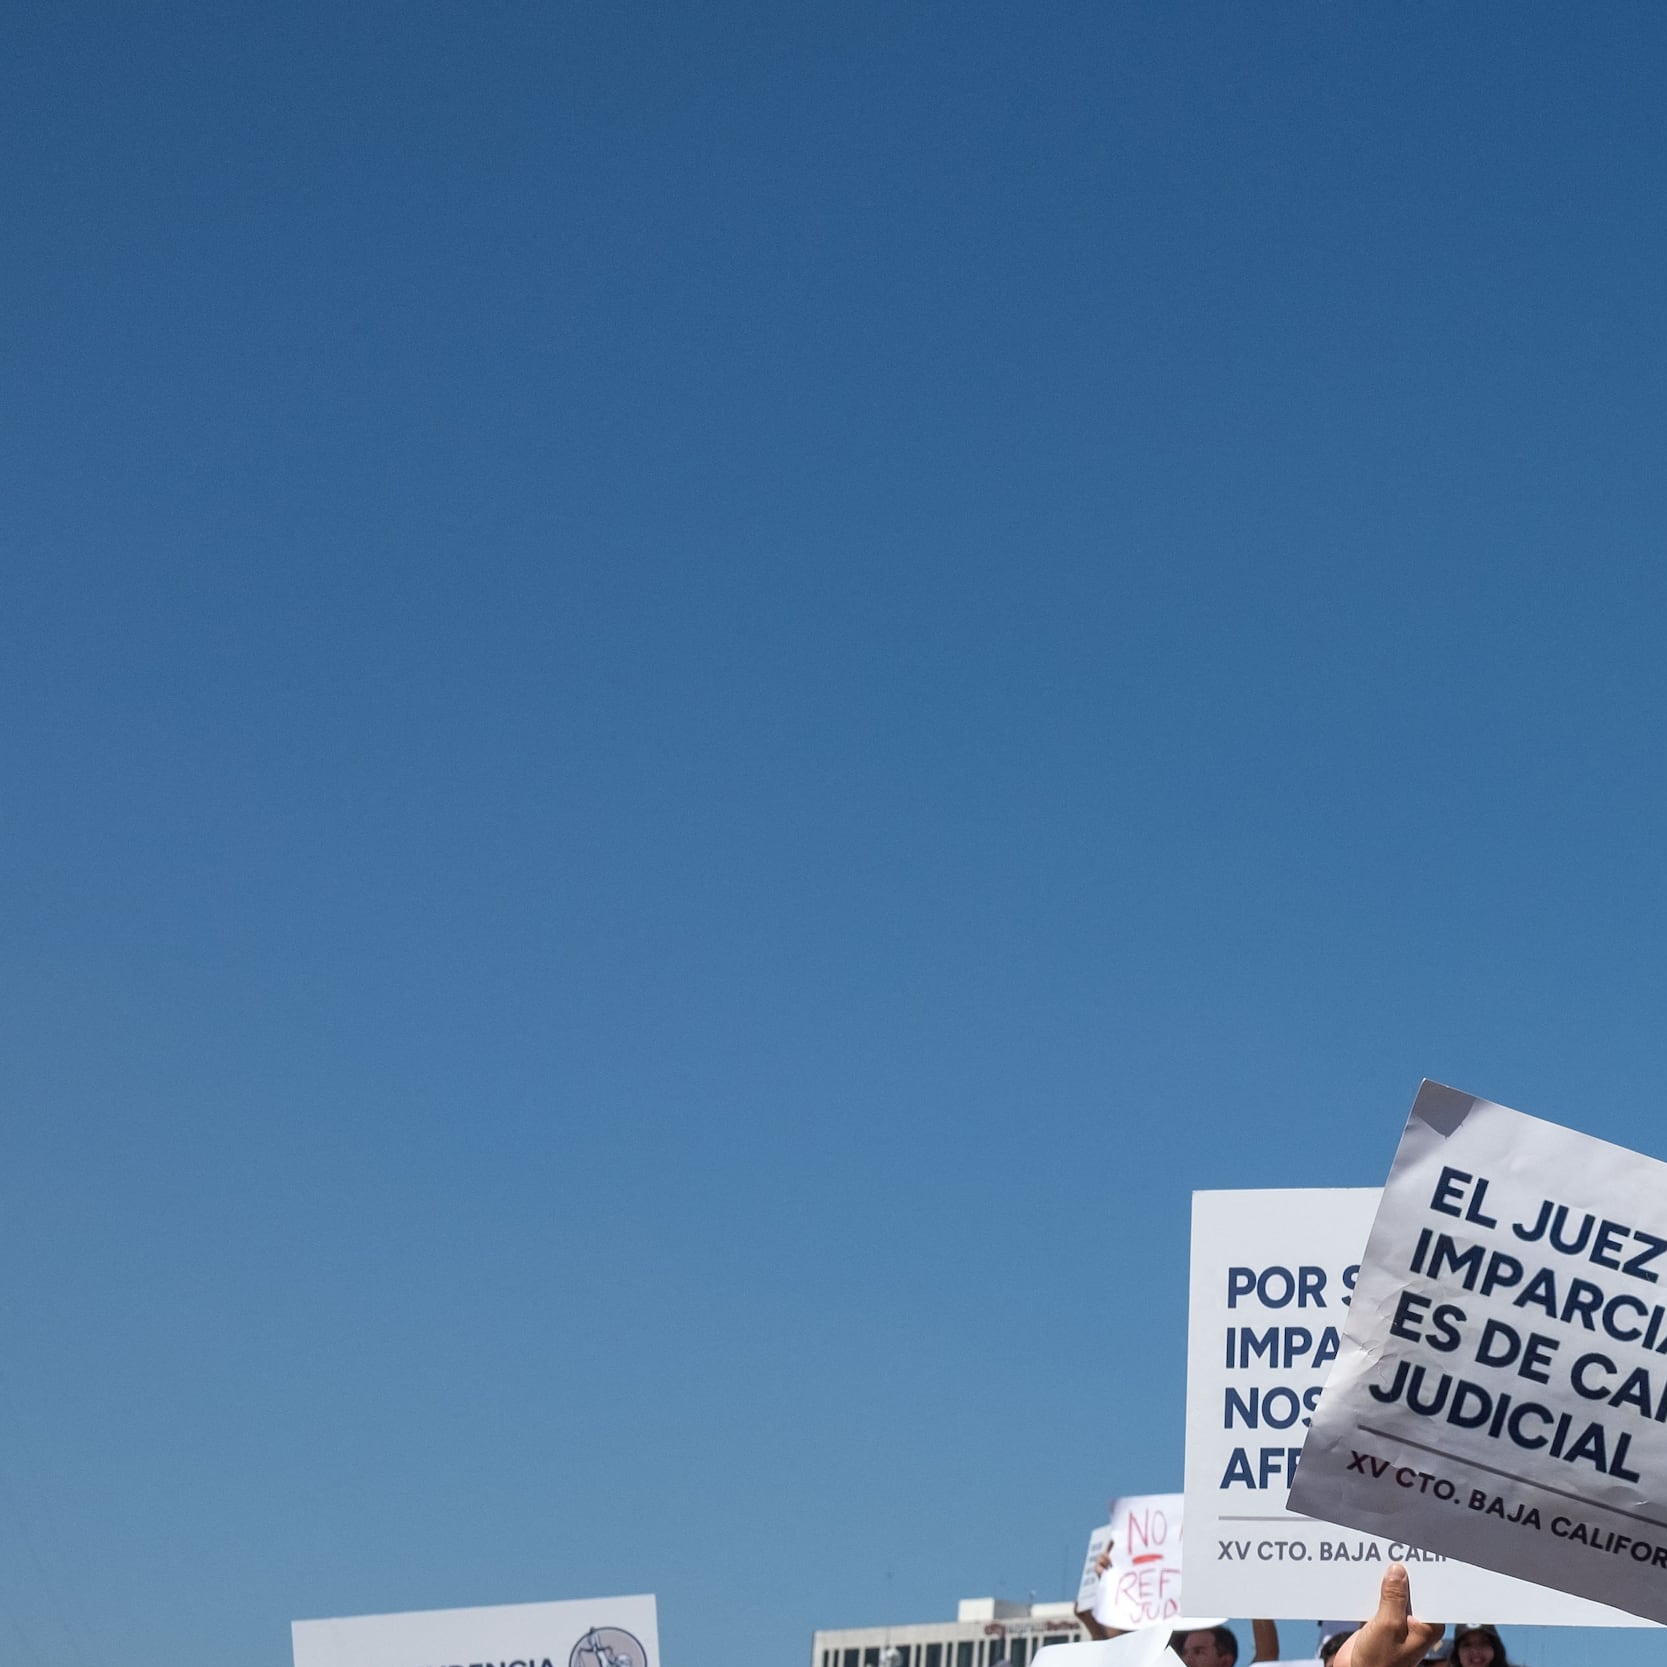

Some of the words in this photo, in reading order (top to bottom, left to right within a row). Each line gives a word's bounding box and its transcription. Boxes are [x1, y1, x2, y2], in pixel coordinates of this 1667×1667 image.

[1430, 1166, 1497, 1229] EL
[1228, 1266, 1327, 1308] POR
[1390, 1291, 1467, 1353] ES
[1475, 1318, 1560, 1385] DE
[1224, 1386, 1325, 1430] NOS
[1369, 1361, 1640, 1484] JUDICIAL
[1347, 1450, 1391, 1479] XV
[1395, 1466, 1460, 1505] CTO.
[1468, 1488, 1541, 1531] BAJA
[1127, 1508, 1169, 1556] NO
[1217, 1541, 1251, 1561] XV
[1257, 1540, 1312, 1562] CTO.
[1320, 1541, 1378, 1562] BAJA
